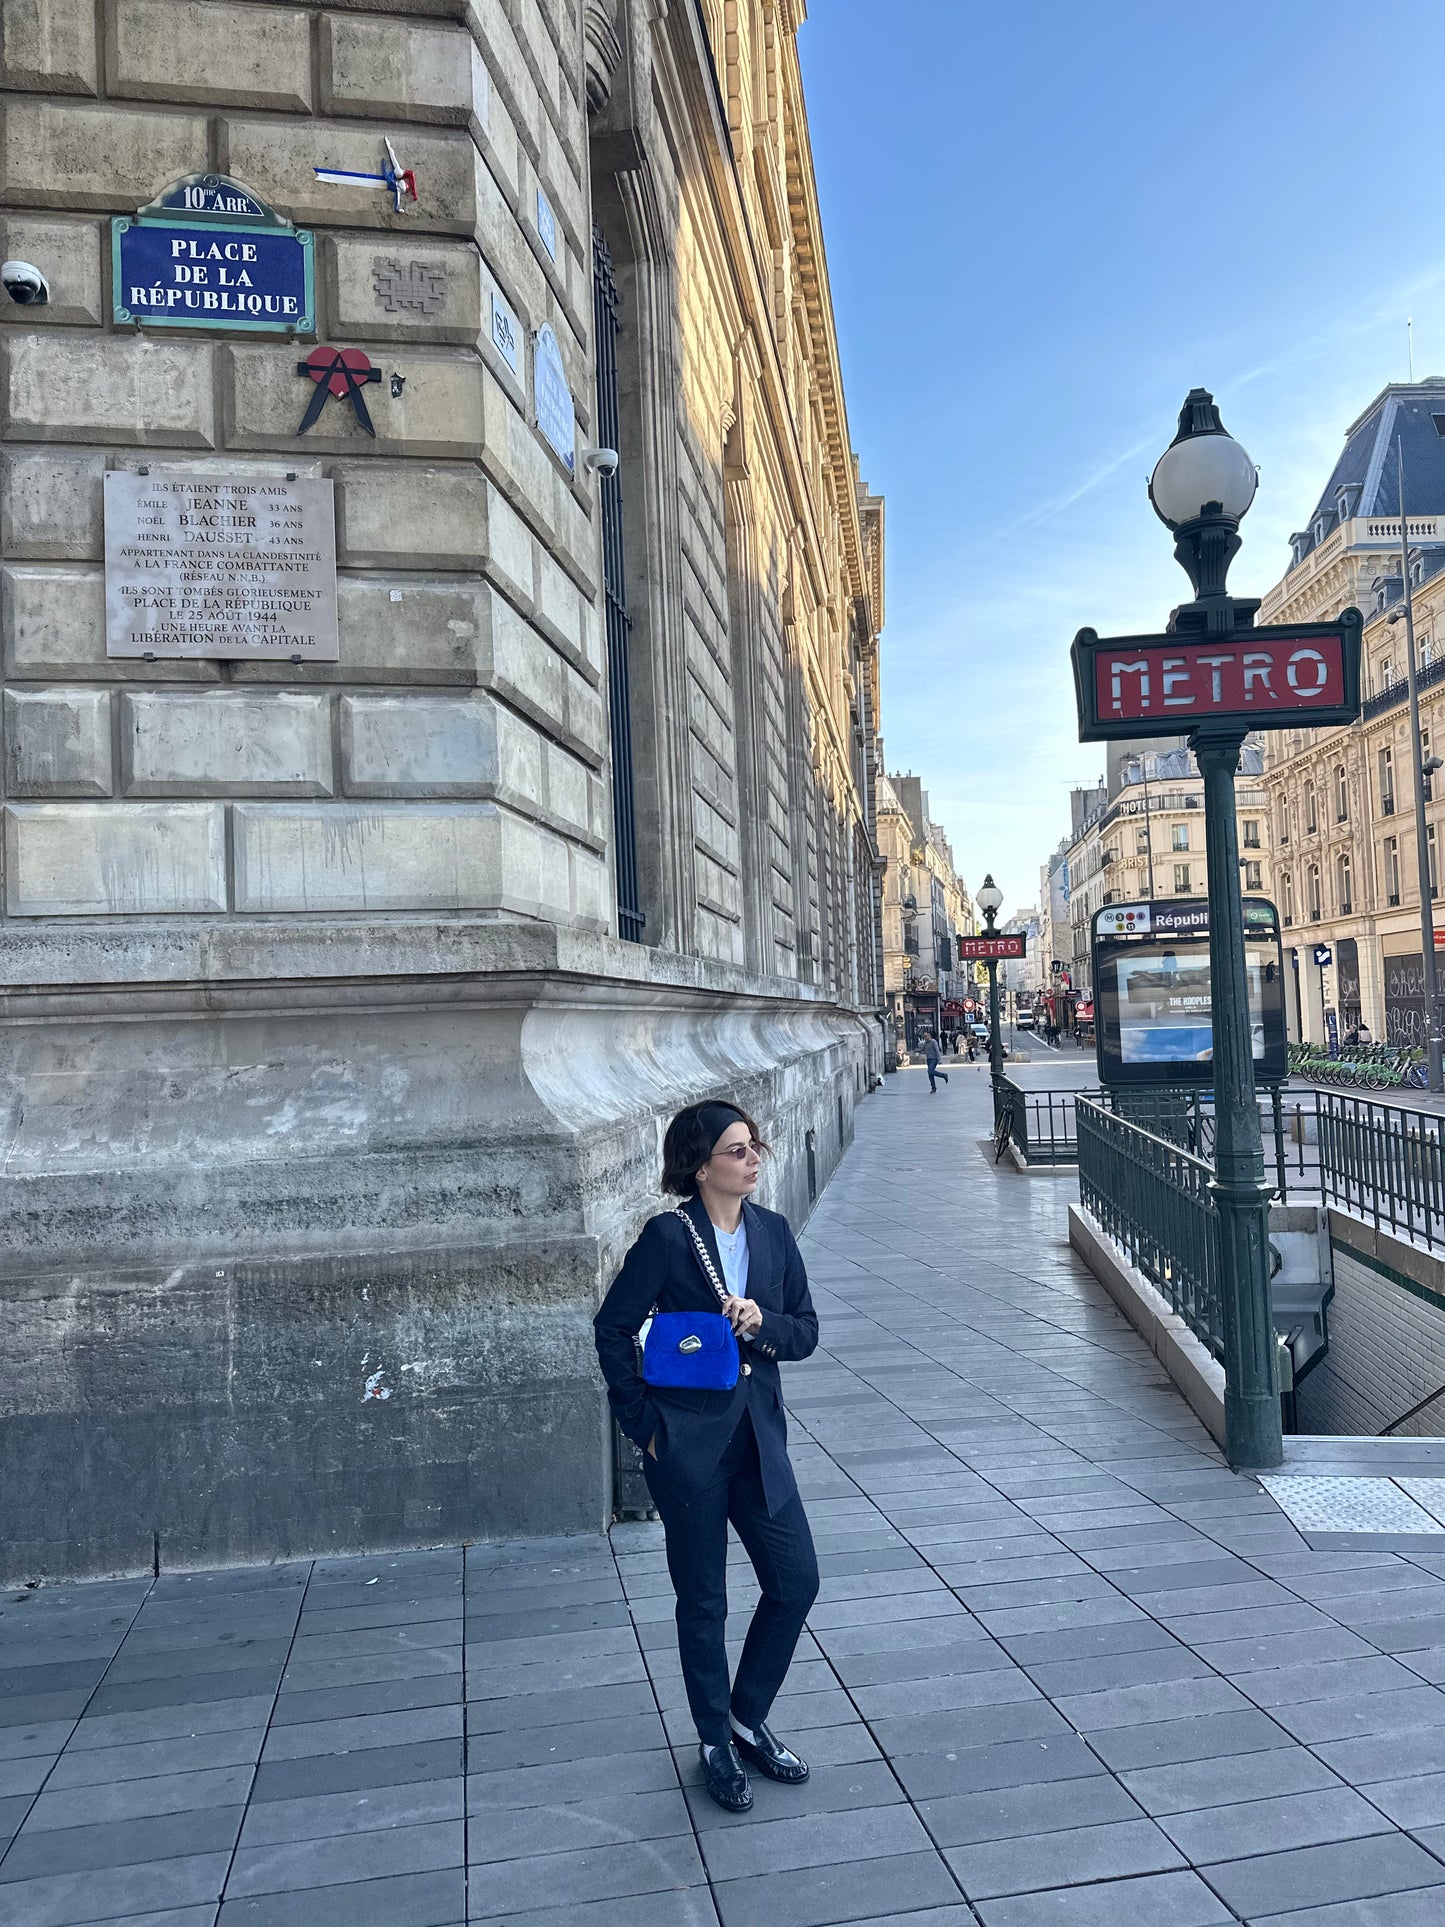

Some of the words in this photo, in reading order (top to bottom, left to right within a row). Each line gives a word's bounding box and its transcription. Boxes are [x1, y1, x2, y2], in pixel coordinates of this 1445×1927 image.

[171, 239, 257, 262] PLACE
[174, 265, 208, 284] DE
[218, 268, 253, 287] LA
[130, 281, 298, 315] RÉPUBLIQUE
[152, 483, 169, 492] ILS
[172, 481, 220, 493] ÉTAIENT
[223, 485, 256, 495] TROIS
[259, 487, 287, 496] AMIS
[137, 498, 168, 509] ÉMILE
[186, 498, 248, 511] JEANNE
[268, 504, 280, 512] 33
[283, 504, 303, 512] ANS
[179, 514, 256, 527] BLACHIER
[269, 520, 280, 528] 36
[283, 521, 303, 529] ANS
[137, 533, 170, 542] HENRI
[184, 530, 253, 543] DAUSSET
[269, 536, 280, 545] 43
[283, 537, 304, 545] ANS
[120, 548, 194, 558] APPARTENANT
[197, 550, 224, 559] DANS
[228, 551, 240, 559] LA
[243, 551, 322, 561] CLANDESTINITÉ
[145, 560, 160, 568] LA
[164, 560, 213, 569] FRANCE
[217, 561, 309, 571] COMBATTANTE
[180, 571, 224, 582] (RÉSEAU
[228, 573, 266, 583] N.N.B.)
[120, 586, 138, 595] ILS
[141, 586, 173, 595] SONT
[176, 586, 223, 596] TOMBÉS
[226, 587, 322, 598] GLORIEUSEMENT
[134, 598, 177, 608] PLACE
[181, 598, 199, 608] DE
[203, 598, 220, 609] LA
[225, 597, 311, 612] RÉPUBLIQUE
[169, 610, 184, 620] LE
[188, 610, 203, 620] 25
[208, 610, 242, 620] AOÛT
[248, 611, 277, 622] 1944
[161, 623, 185, 631] UNE
[189, 623, 228, 632] HEURE
[231, 624, 268, 633] AVANT
[272, 625, 286, 633] LA
[131, 630, 213, 643] LIBÉRATION
[235, 636, 248, 644] LA
[251, 634, 315, 645] CAPITALE
[1111, 649, 1328, 709] METRO
[1123, 800, 1154, 815] HOTEL
[1155, 912, 1209, 928] Républi
[964, 940, 1018, 955] METRO
[1169, 997, 1182, 1006] THE
